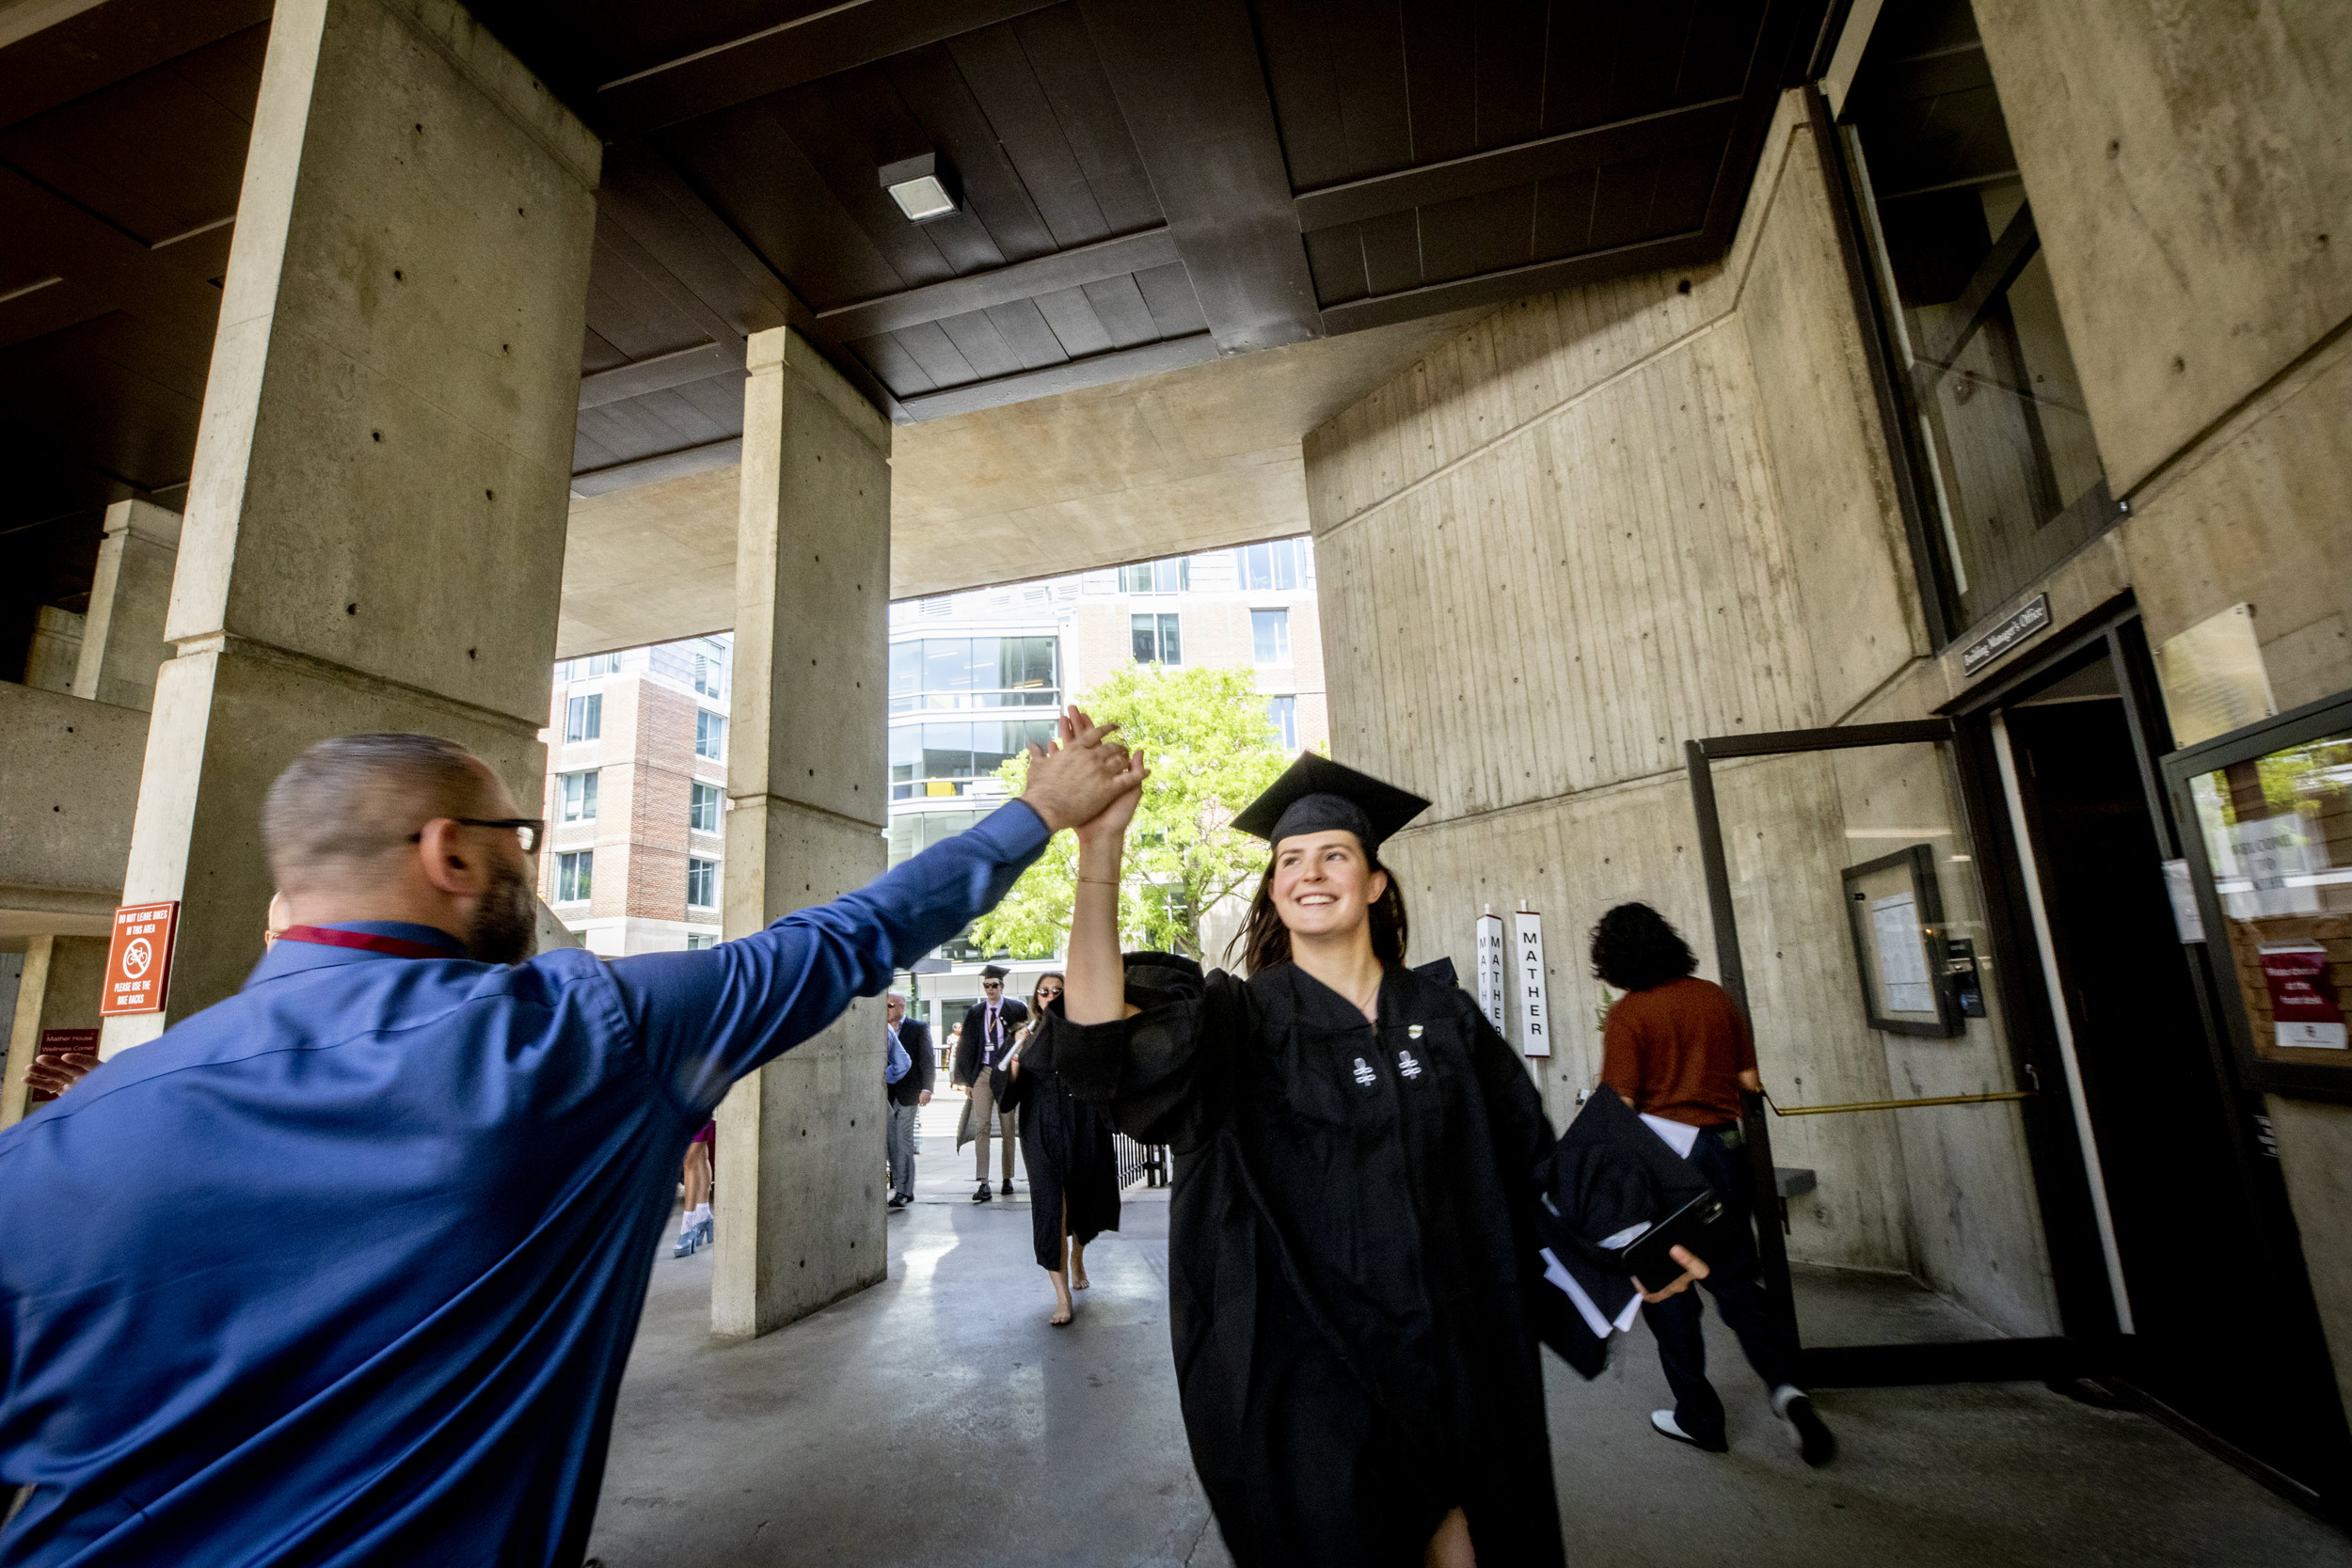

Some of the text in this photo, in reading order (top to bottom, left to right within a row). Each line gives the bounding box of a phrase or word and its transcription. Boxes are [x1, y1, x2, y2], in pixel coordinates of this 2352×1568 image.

[119, 910, 167, 924] DO NOT LEAVE BIKES
[126, 924, 155, 936] IN THIS AREA
[114, 980, 151, 992] PLEASE USE THE
[1523, 932, 1542, 1035] MATHER
[117, 993, 145, 1006] BIKE RACKS
